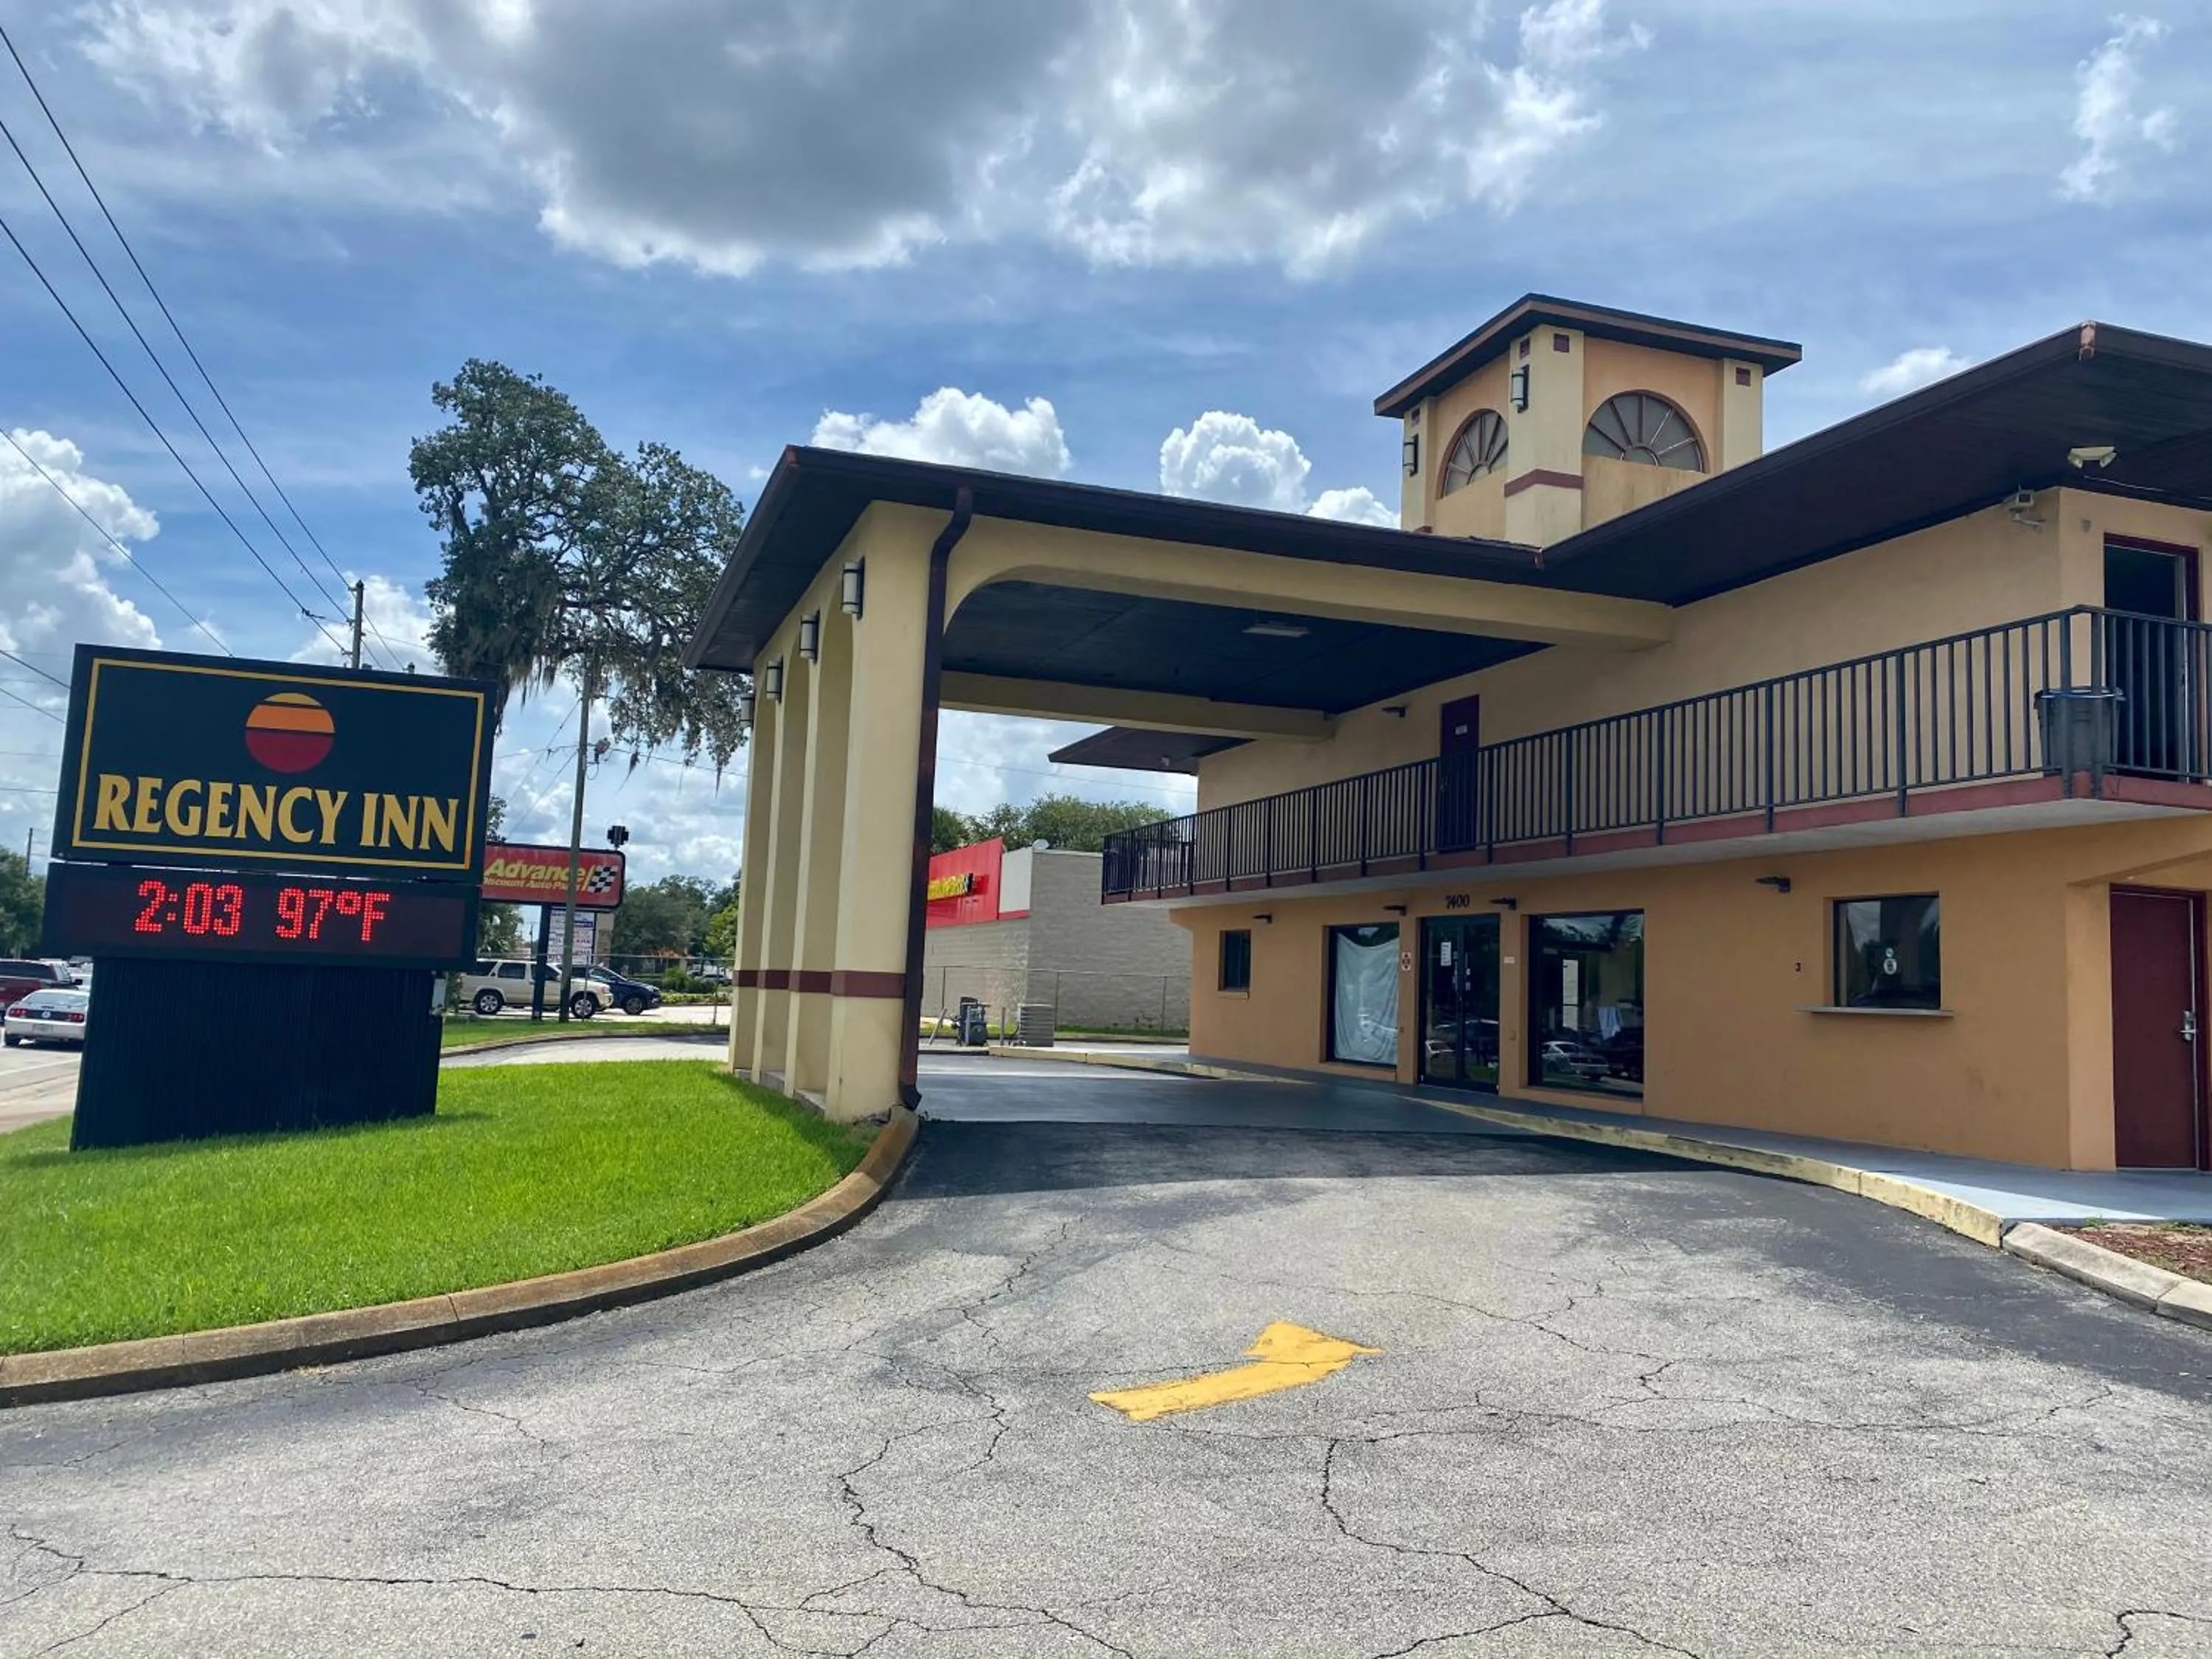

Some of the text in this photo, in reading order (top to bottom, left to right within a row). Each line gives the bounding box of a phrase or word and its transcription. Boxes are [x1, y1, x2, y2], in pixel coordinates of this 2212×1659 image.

[93, 773, 459, 852] REGENCY INN
[484, 858, 586, 883] Advance
[134, 880, 243, 935] 2:03
[1445, 894, 1470, 909] 7400
